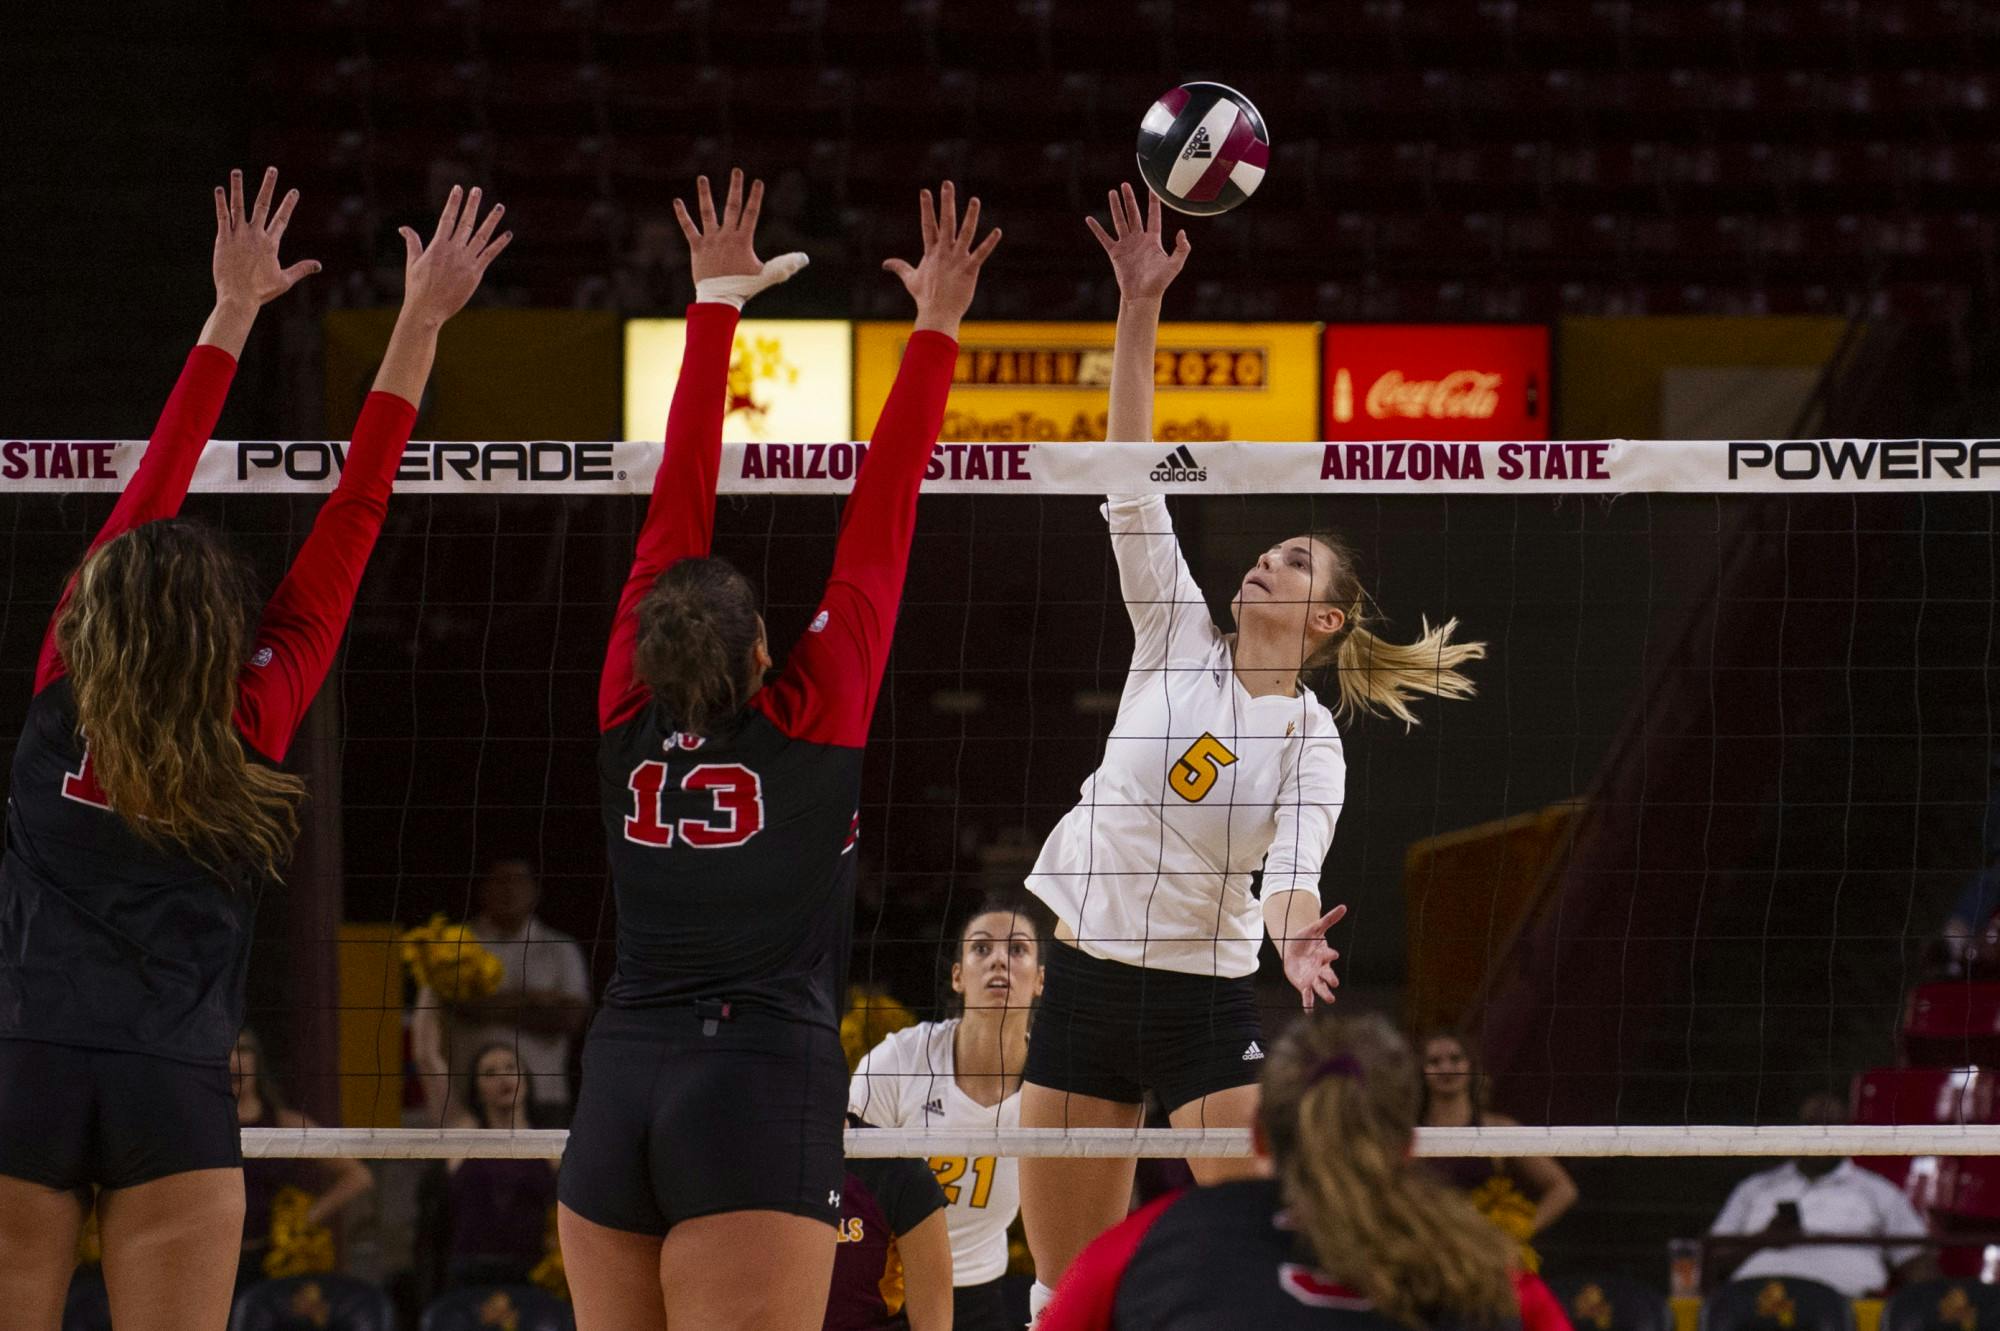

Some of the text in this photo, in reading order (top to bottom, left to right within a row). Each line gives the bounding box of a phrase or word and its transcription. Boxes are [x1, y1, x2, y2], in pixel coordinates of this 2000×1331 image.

[1182, 126, 1207, 160] adidas
[2, 442, 118, 479] STATE
[237, 442, 614, 480] POERADE
[741, 443, 868, 480] ARIZO
[1150, 467, 1207, 482] adidas
[1320, 443, 1610, 480] ARIZONA STATE
[1168, 731, 1239, 803] 5
[624, 759, 764, 848] 13
[928, 1157, 996, 1208] 21
[837, 1217, 864, 1242] LS
